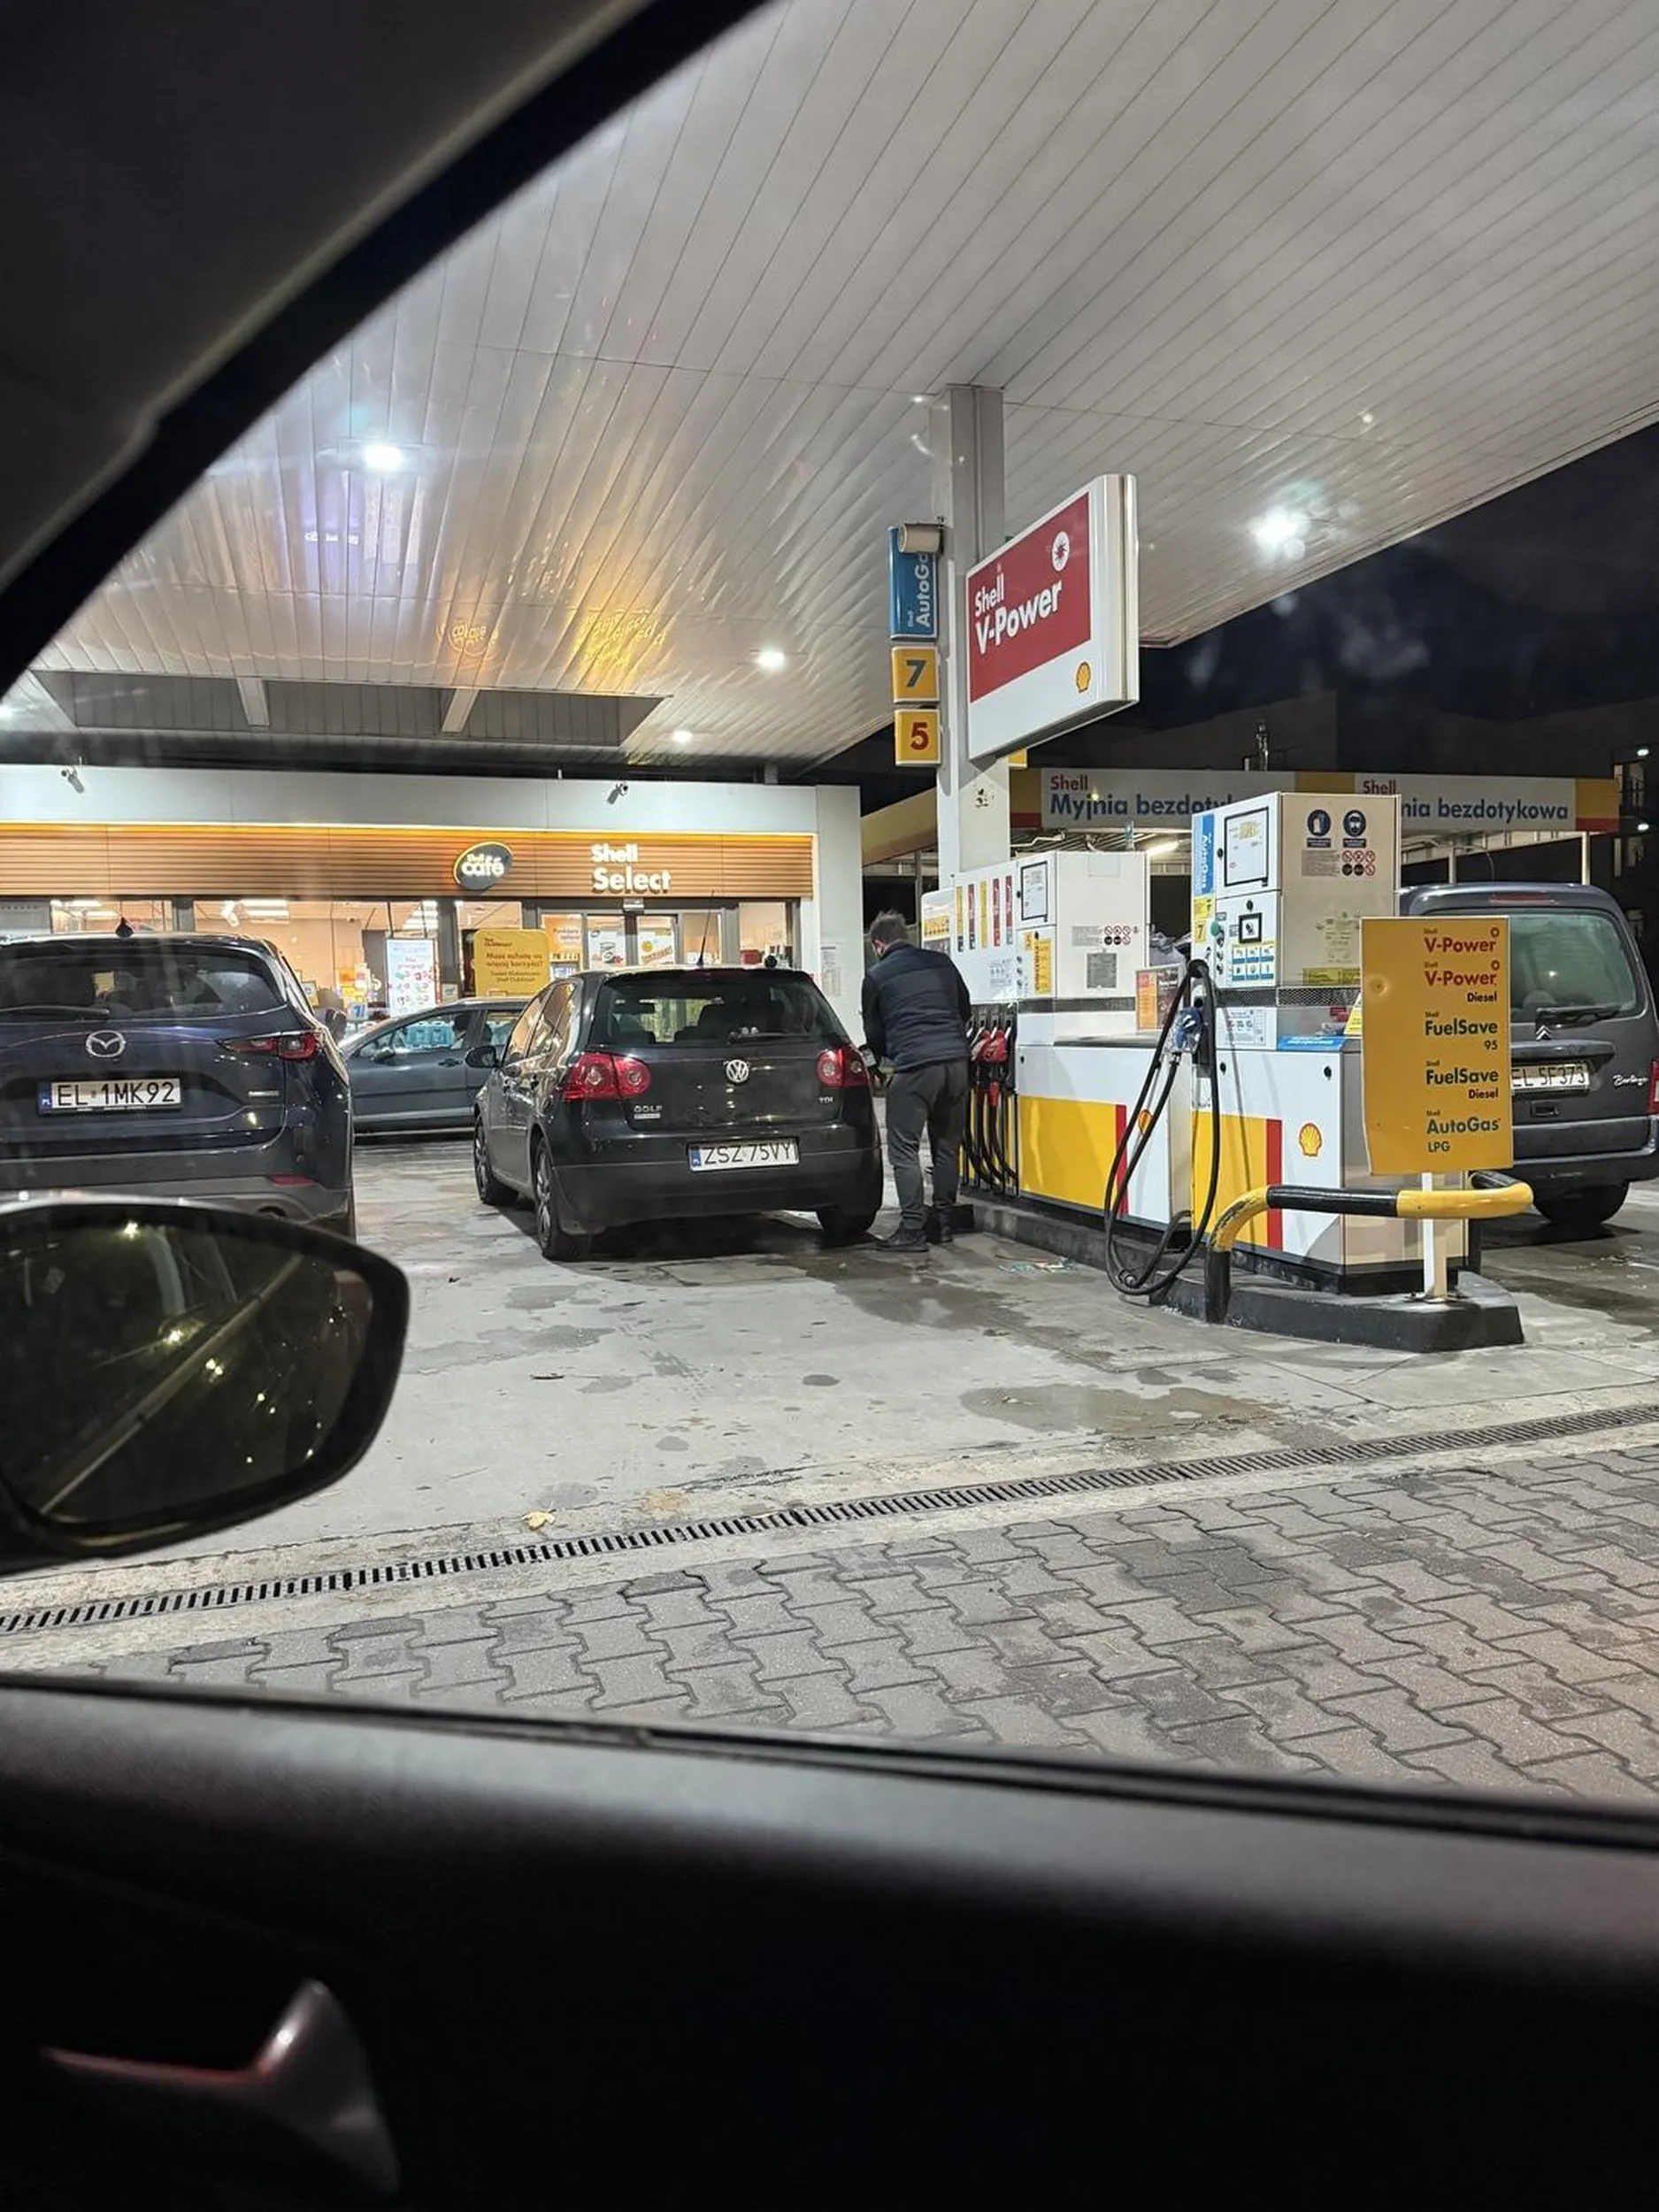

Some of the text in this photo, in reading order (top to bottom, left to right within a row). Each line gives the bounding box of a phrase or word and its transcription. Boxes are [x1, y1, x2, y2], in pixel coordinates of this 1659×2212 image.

[975, 572, 1004, 617] Shell
[975, 579, 1062, 655] V-Power
[905, 659, 927, 687] 7
[910, 722, 929, 750] 5
[1050, 775, 1088, 790] Shell
[1363, 780, 1396, 795] Shell
[1050, 794, 1128, 820] Myjnia
[1438, 798, 1569, 824] bezdotykowa
[591, 842, 639, 864] Shell
[461, 855, 505, 878] café
[593, 865, 672, 891] Select
[1424, 936, 1497, 953] V-Power
[1424, 970, 1497, 987] V-Power
[1467, 991, 1497, 1002] Diesel
[1425, 1018, 1499, 1035] FuelSave
[1485, 1040, 1498, 1050] 95
[1425, 1067, 1499, 1085] FuelSave
[1539, 1065, 1586, 1086] 5F373
[58, 1081, 175, 1106] EL 1MK92
[1469, 1087, 1499, 1099] Diesel
[1426, 1116, 1500, 1134] AutoGas
[703, 1146, 744, 1165] ZSZ
[747, 1141, 792, 1161] 75VY
[1428, 1140, 1451, 1153] LPG
